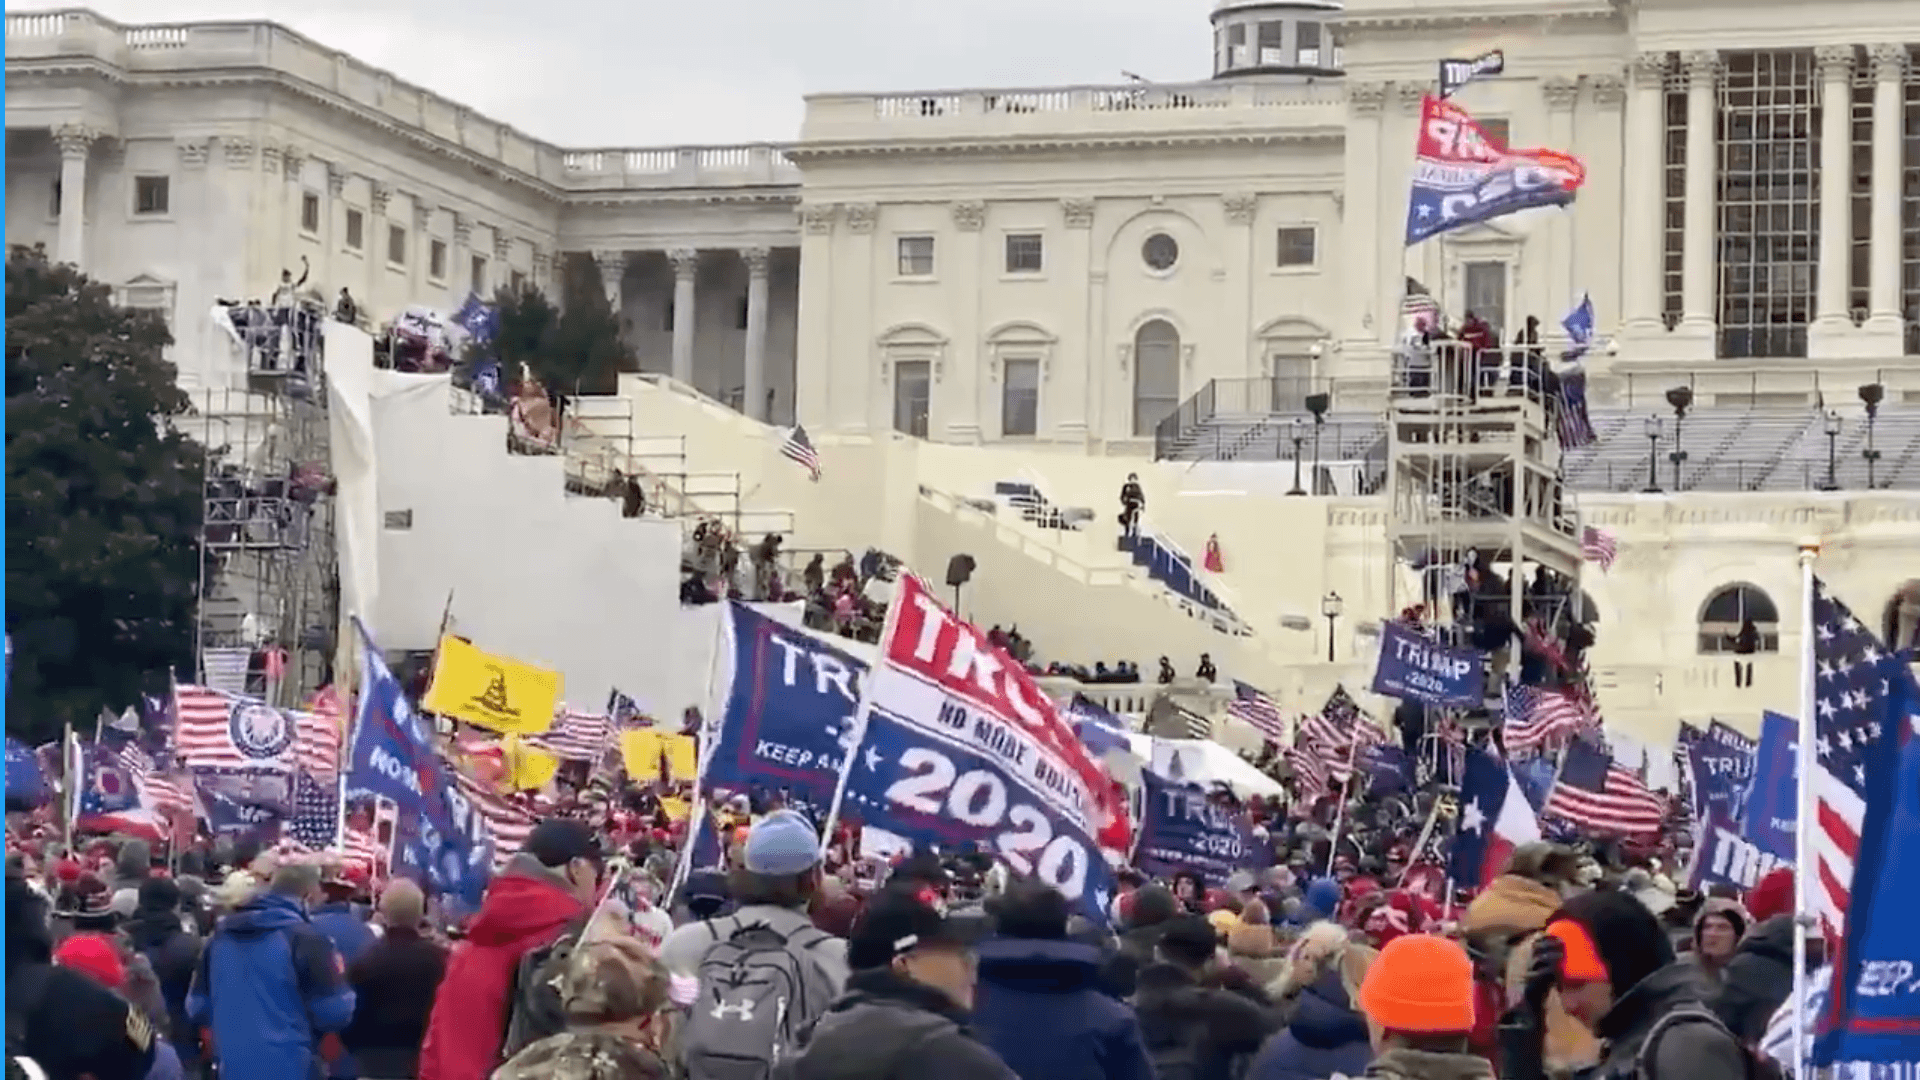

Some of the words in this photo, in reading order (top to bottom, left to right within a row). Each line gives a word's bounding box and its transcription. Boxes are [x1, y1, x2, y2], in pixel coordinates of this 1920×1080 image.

[912, 592, 1047, 728] TRU
[756, 739, 813, 767] KEEP
[937, 701, 967, 730] NO
[974, 716, 1030, 766] MORE
[1702, 756, 1751, 779] TRU
[884, 747, 1088, 900] 2020
